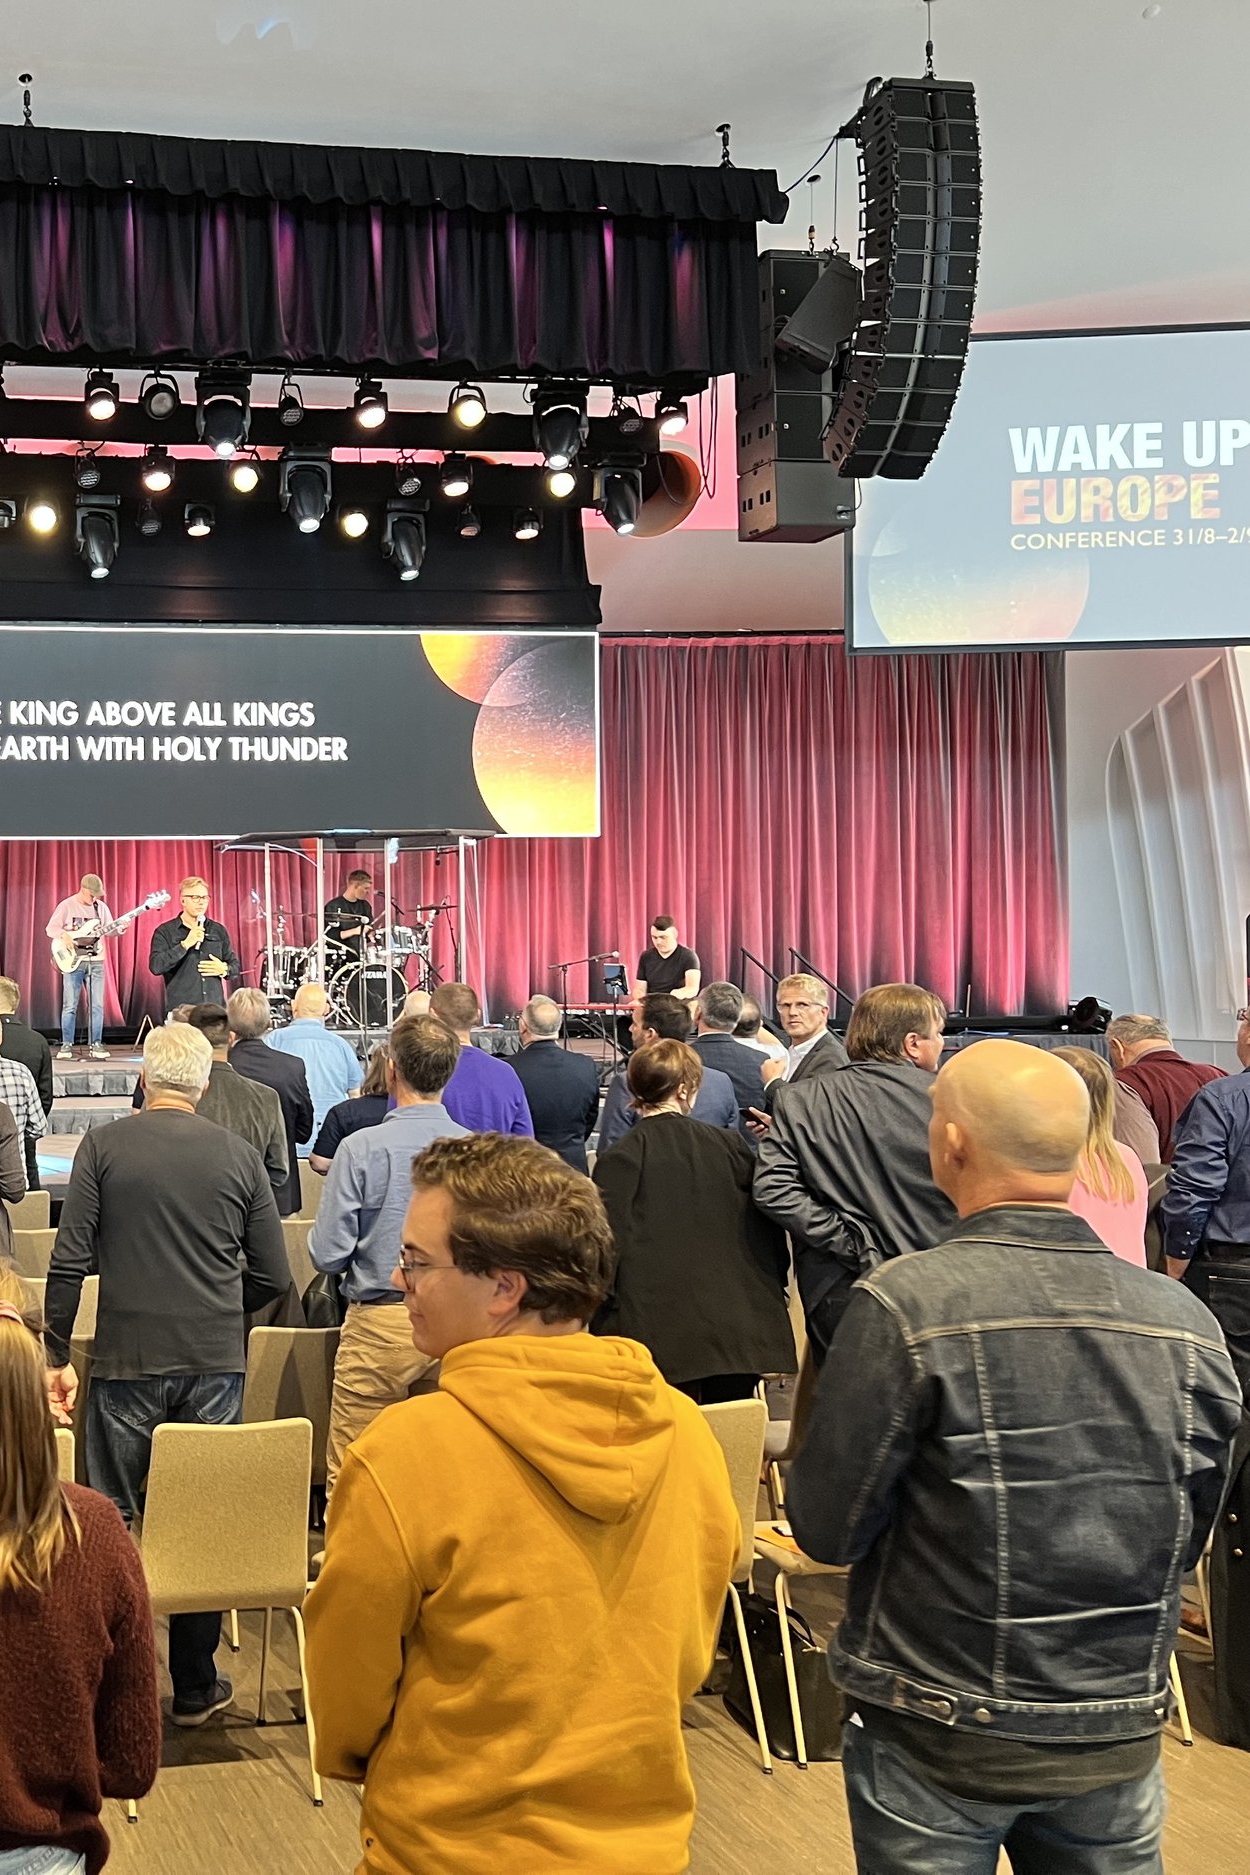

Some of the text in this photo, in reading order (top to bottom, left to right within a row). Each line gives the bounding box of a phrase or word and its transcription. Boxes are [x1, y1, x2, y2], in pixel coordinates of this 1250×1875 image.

[1008, 419, 1250, 473] WAKE UP
[1011, 473, 1221, 525] EUROPE
[1010, 530, 1166, 550] CONFERENCE
[9, 699, 80, 727] KING
[85, 700, 177, 727] ABOVE
[182, 700, 228, 727] ALL
[232, 701, 316, 728] KINGS
[75, 735, 145, 762] WITH
[152, 735, 223, 762] HOLY
[227, 735, 349, 763] THUNDER
